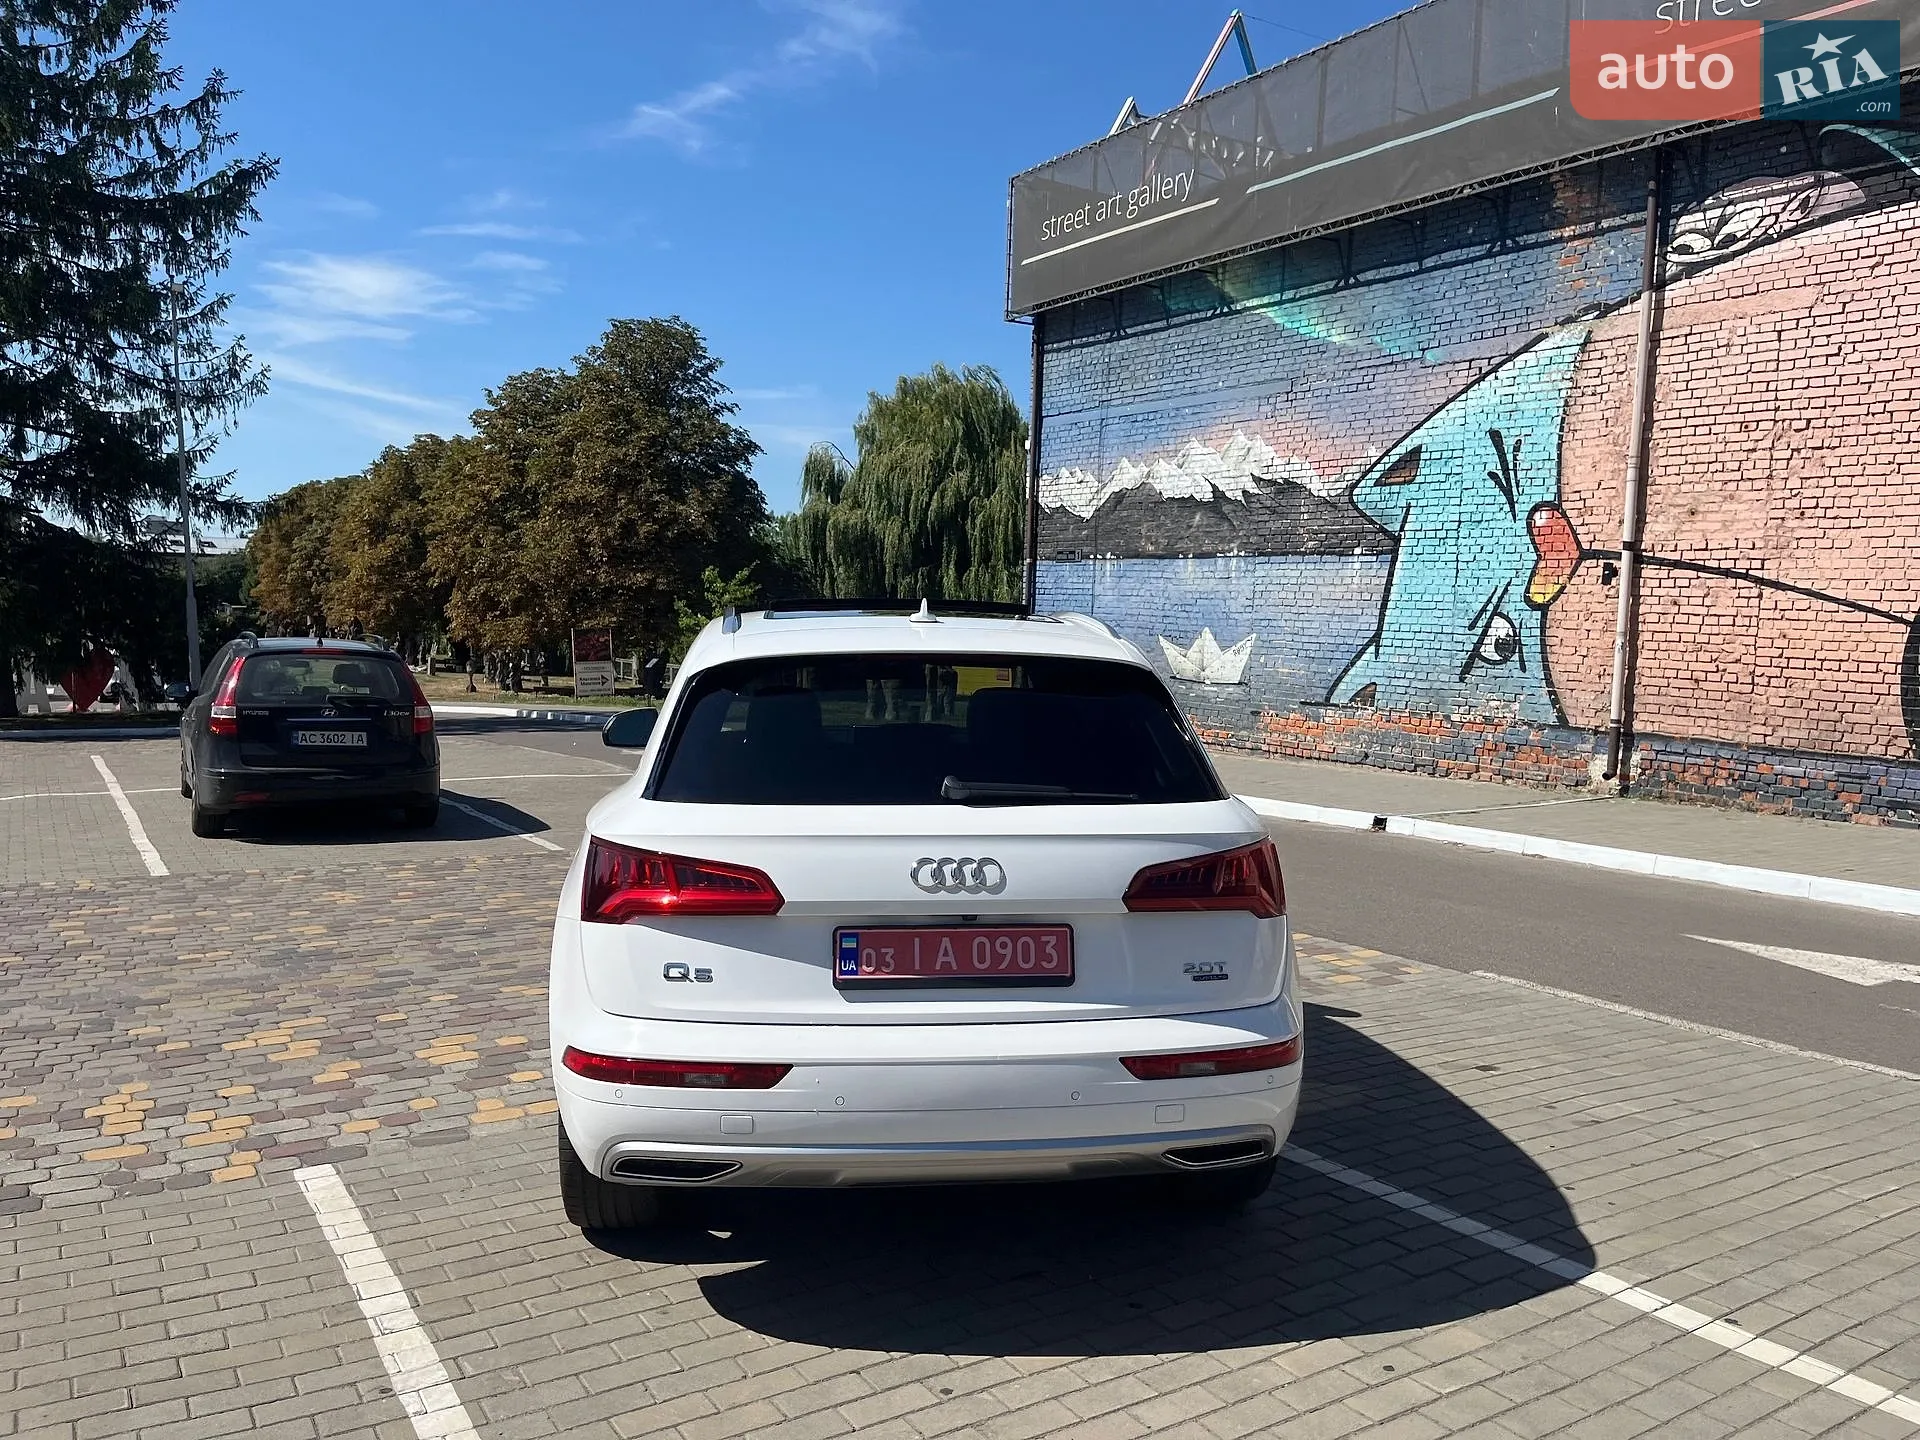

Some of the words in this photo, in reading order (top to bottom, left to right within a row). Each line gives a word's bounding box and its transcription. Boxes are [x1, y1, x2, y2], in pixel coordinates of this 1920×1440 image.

[1041, 202, 1091, 241] street
[1095, 192, 1123, 222] art
[1126, 168, 1195, 219] gallery
[299, 733, 317, 744] AC
[319, 733, 346, 744] 3602
[351, 733, 364, 744] IA
[861, 947, 896, 973] 03
[972, 935, 1059, 970] 0903
[663, 962, 713, 983] Q5
[841, 959, 857, 971] UA
